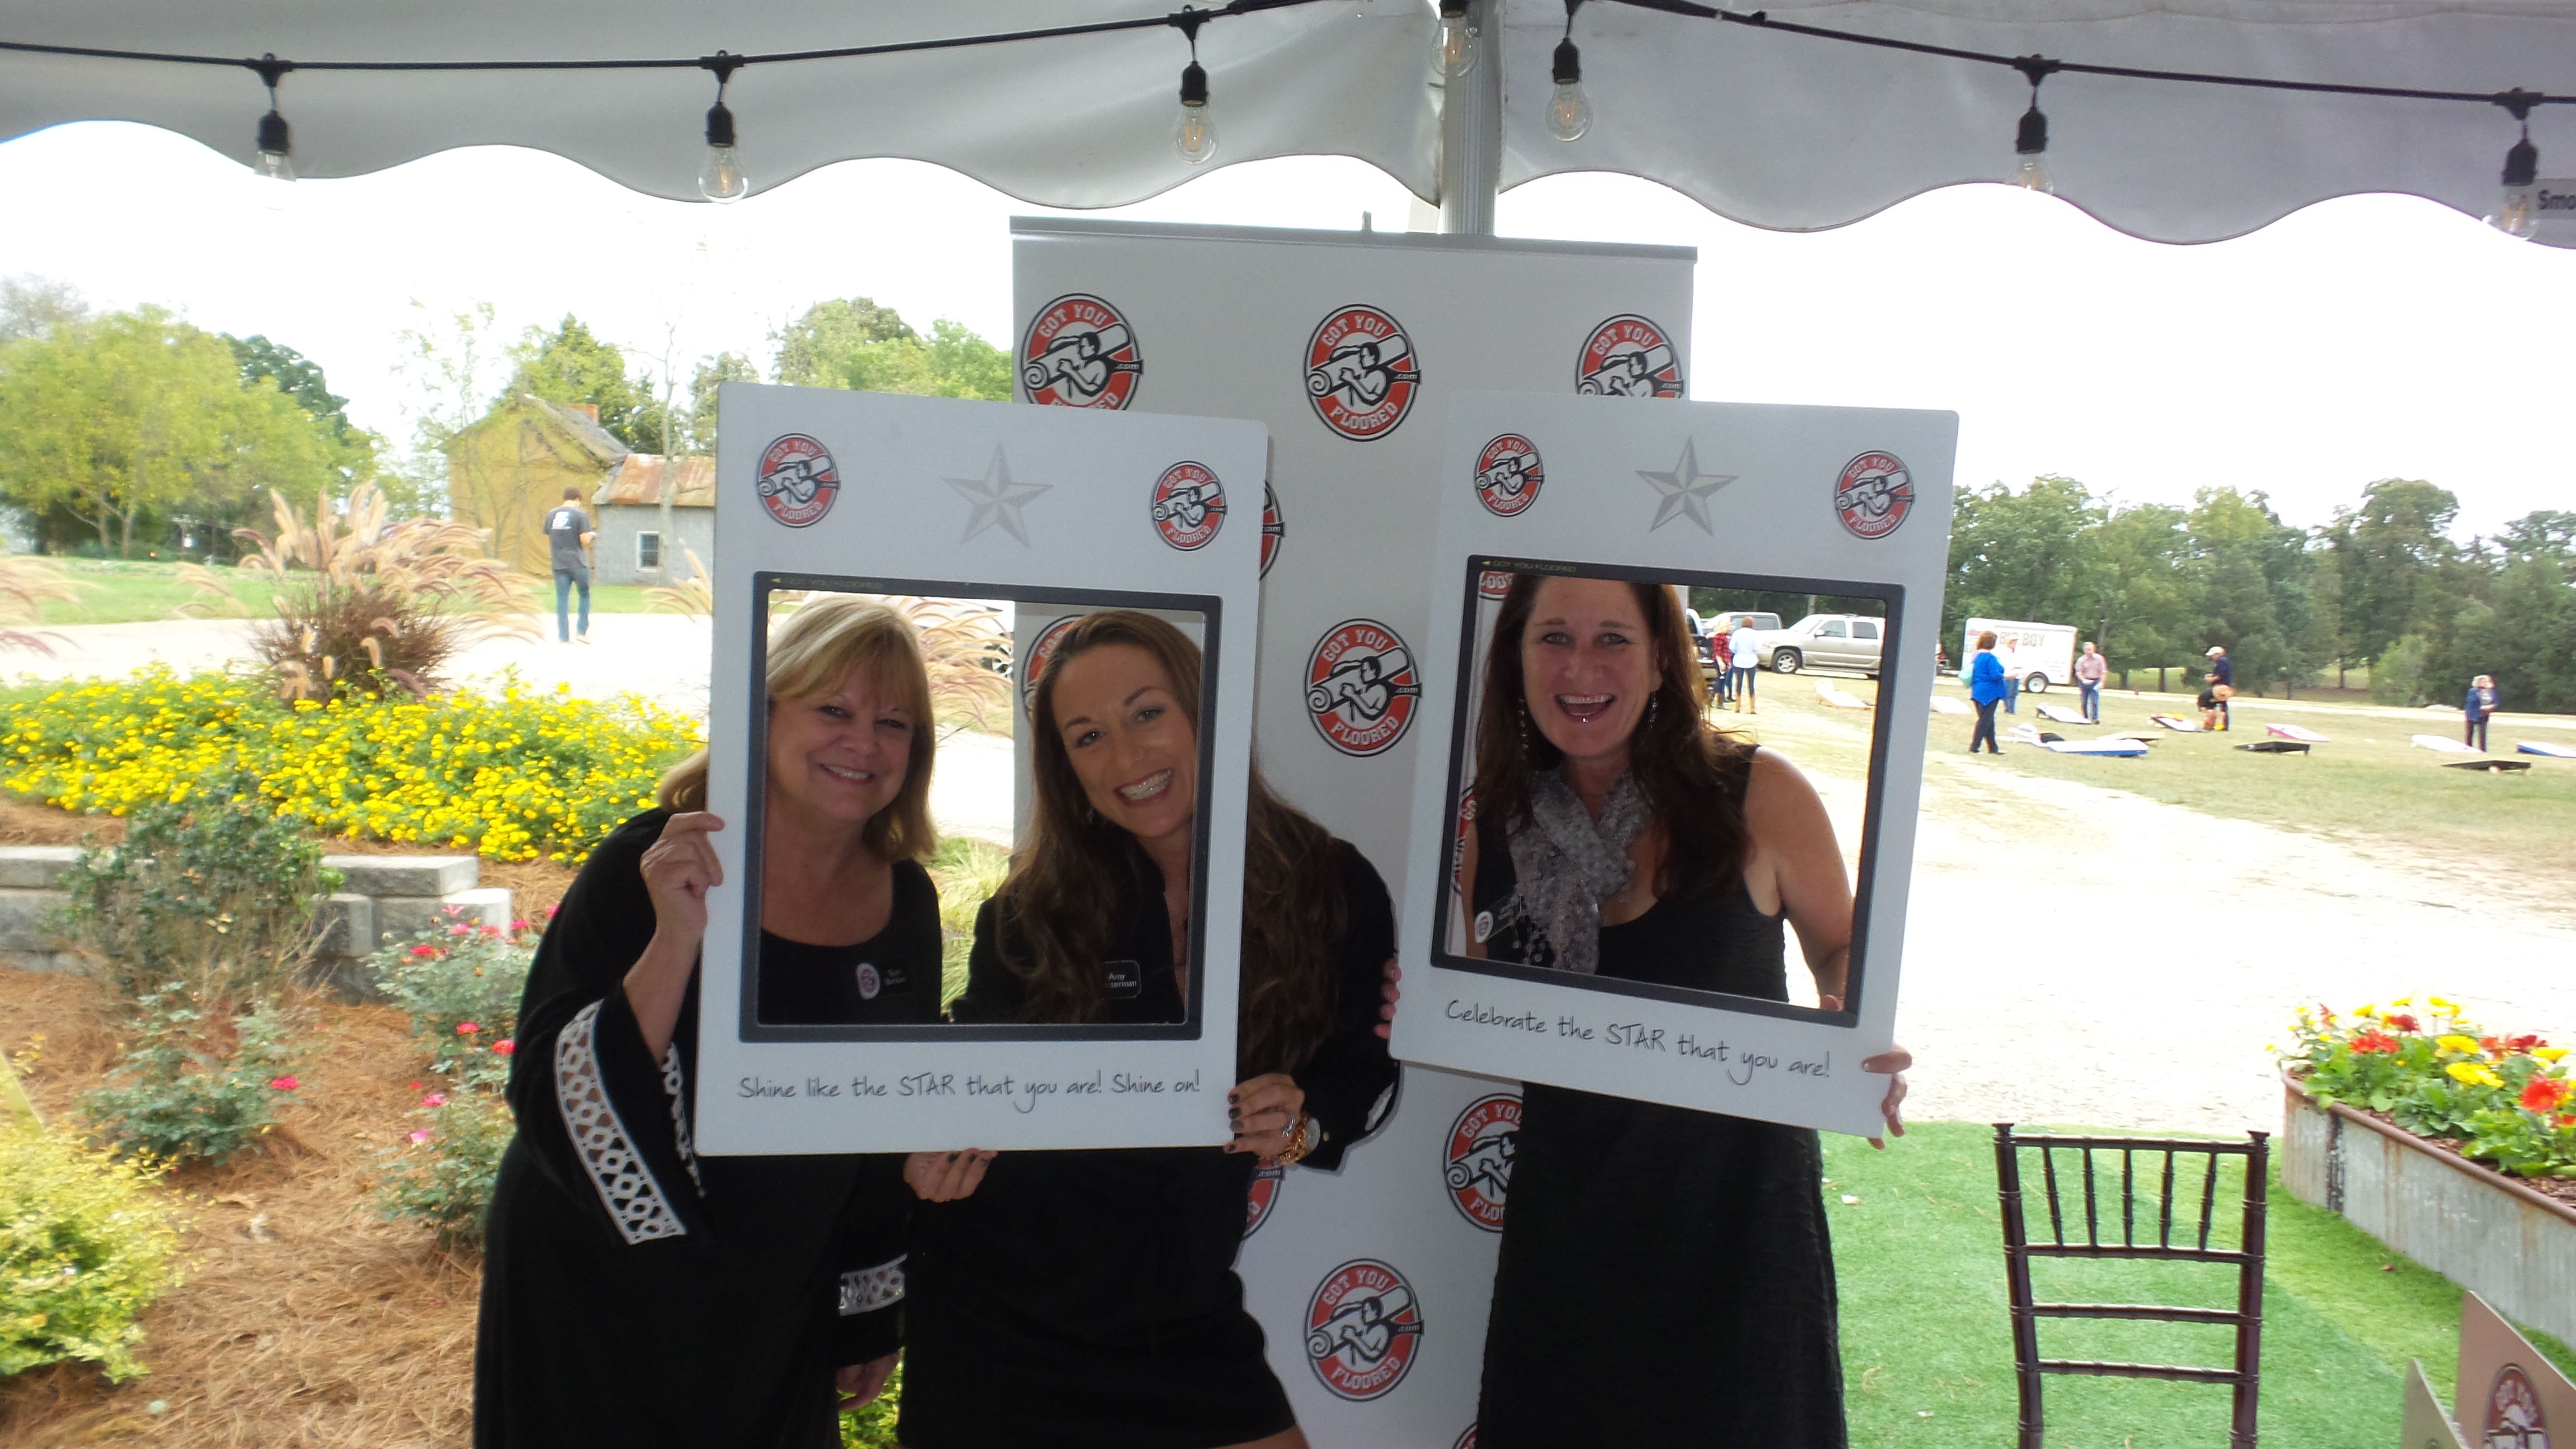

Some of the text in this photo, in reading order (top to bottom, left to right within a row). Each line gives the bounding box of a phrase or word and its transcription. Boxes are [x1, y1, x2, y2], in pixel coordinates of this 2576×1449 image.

[1039, 304, 1109, 338] GOT YOU
[1321, 315, 1388, 346] GOT YOU
[1592, 325, 1655, 356] GOT YOU
[1328, 401, 1399, 430] FLOORED
[770, 441, 818, 462] GOT YOU
[1485, 439, 1527, 460] GOT YOU
[1164, 468, 1208, 489] GOT YOU
[1847, 457, 1896, 478] GOT YOU
[774, 501, 823, 520] FLOORED
[1848, 514, 1897, 532] FLOORED
[1167, 525, 1212, 543] FLOORED
[1322, 629, 1389, 661] GOT YOU
[2021, 633, 2045, 647] BOY
[1330, 716, 1400, 746] FLOORED
[1445, 998, 1830, 1086] Celebrate the STAR that you are!
[738, 1068, 1201, 1114] Shine like the STAR that you are! Shine on!
[1461, 1109, 1489, 1138] GOT
[1323, 1270, 1390, 1305] GOT YOU
[1330, 1356, 1401, 1390] FLOORED
